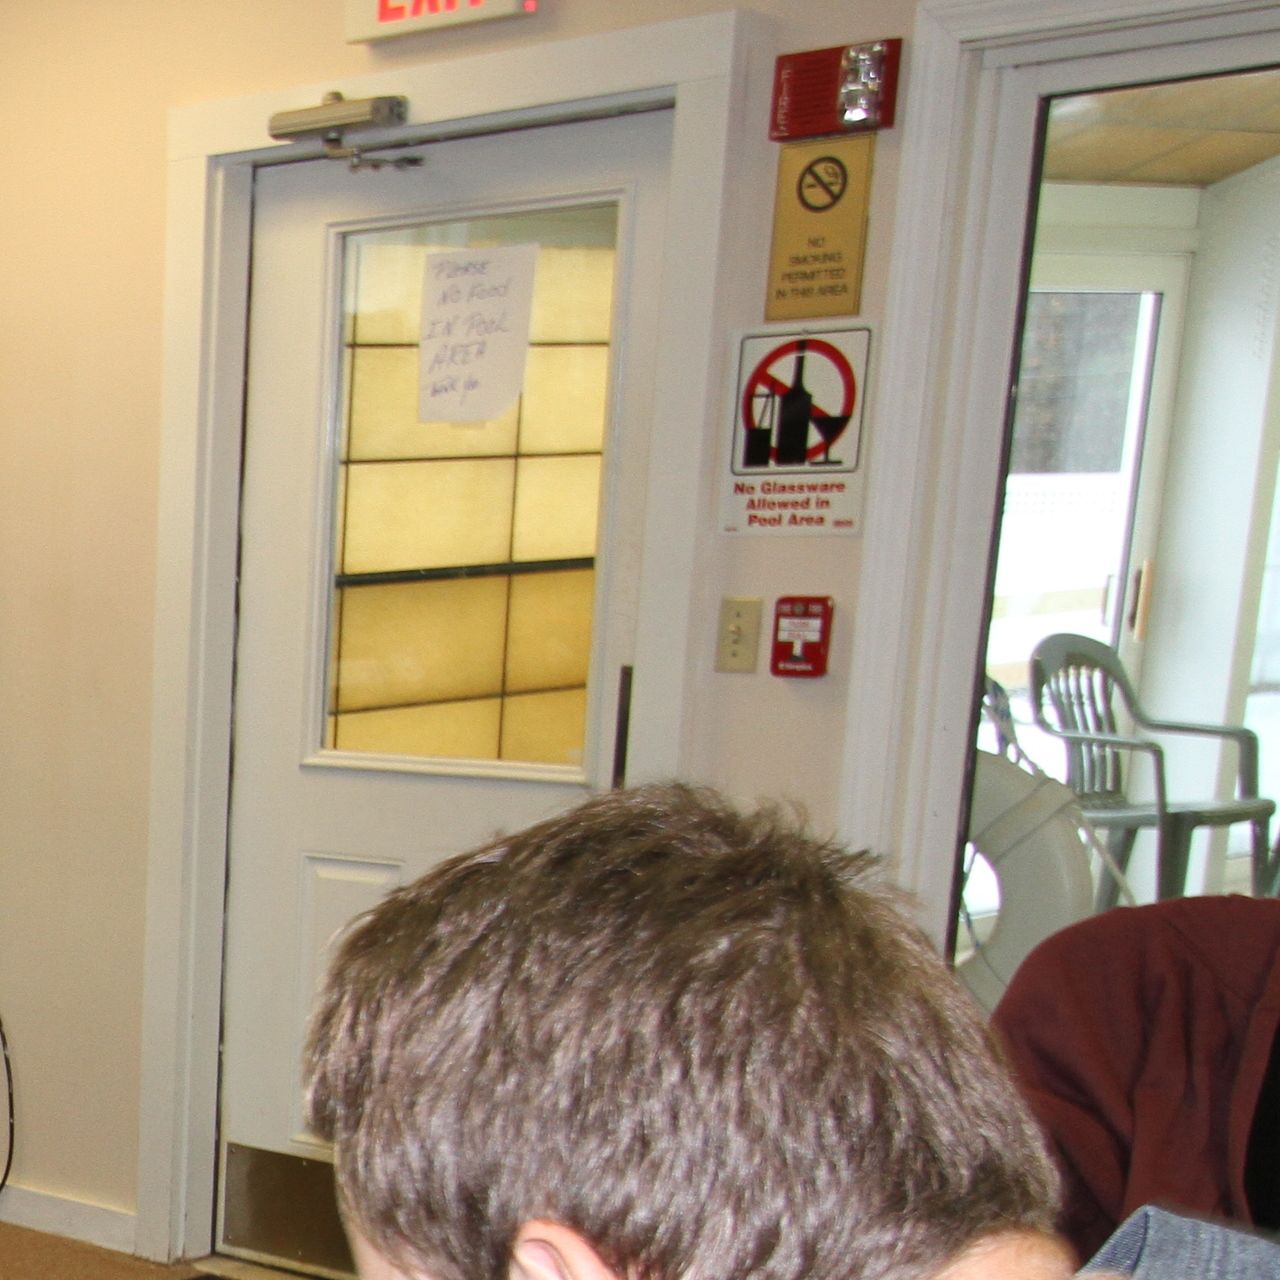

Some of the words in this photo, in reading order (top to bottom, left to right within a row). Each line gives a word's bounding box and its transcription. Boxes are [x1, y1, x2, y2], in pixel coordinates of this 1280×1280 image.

[734, 482, 755, 495] No
[761, 481, 846, 495] Glassware
[746, 497, 811, 511] Allowed
[815, 497, 830, 509] in
[748, 513, 782, 527] Pool
[788, 513, 825, 526] Area
